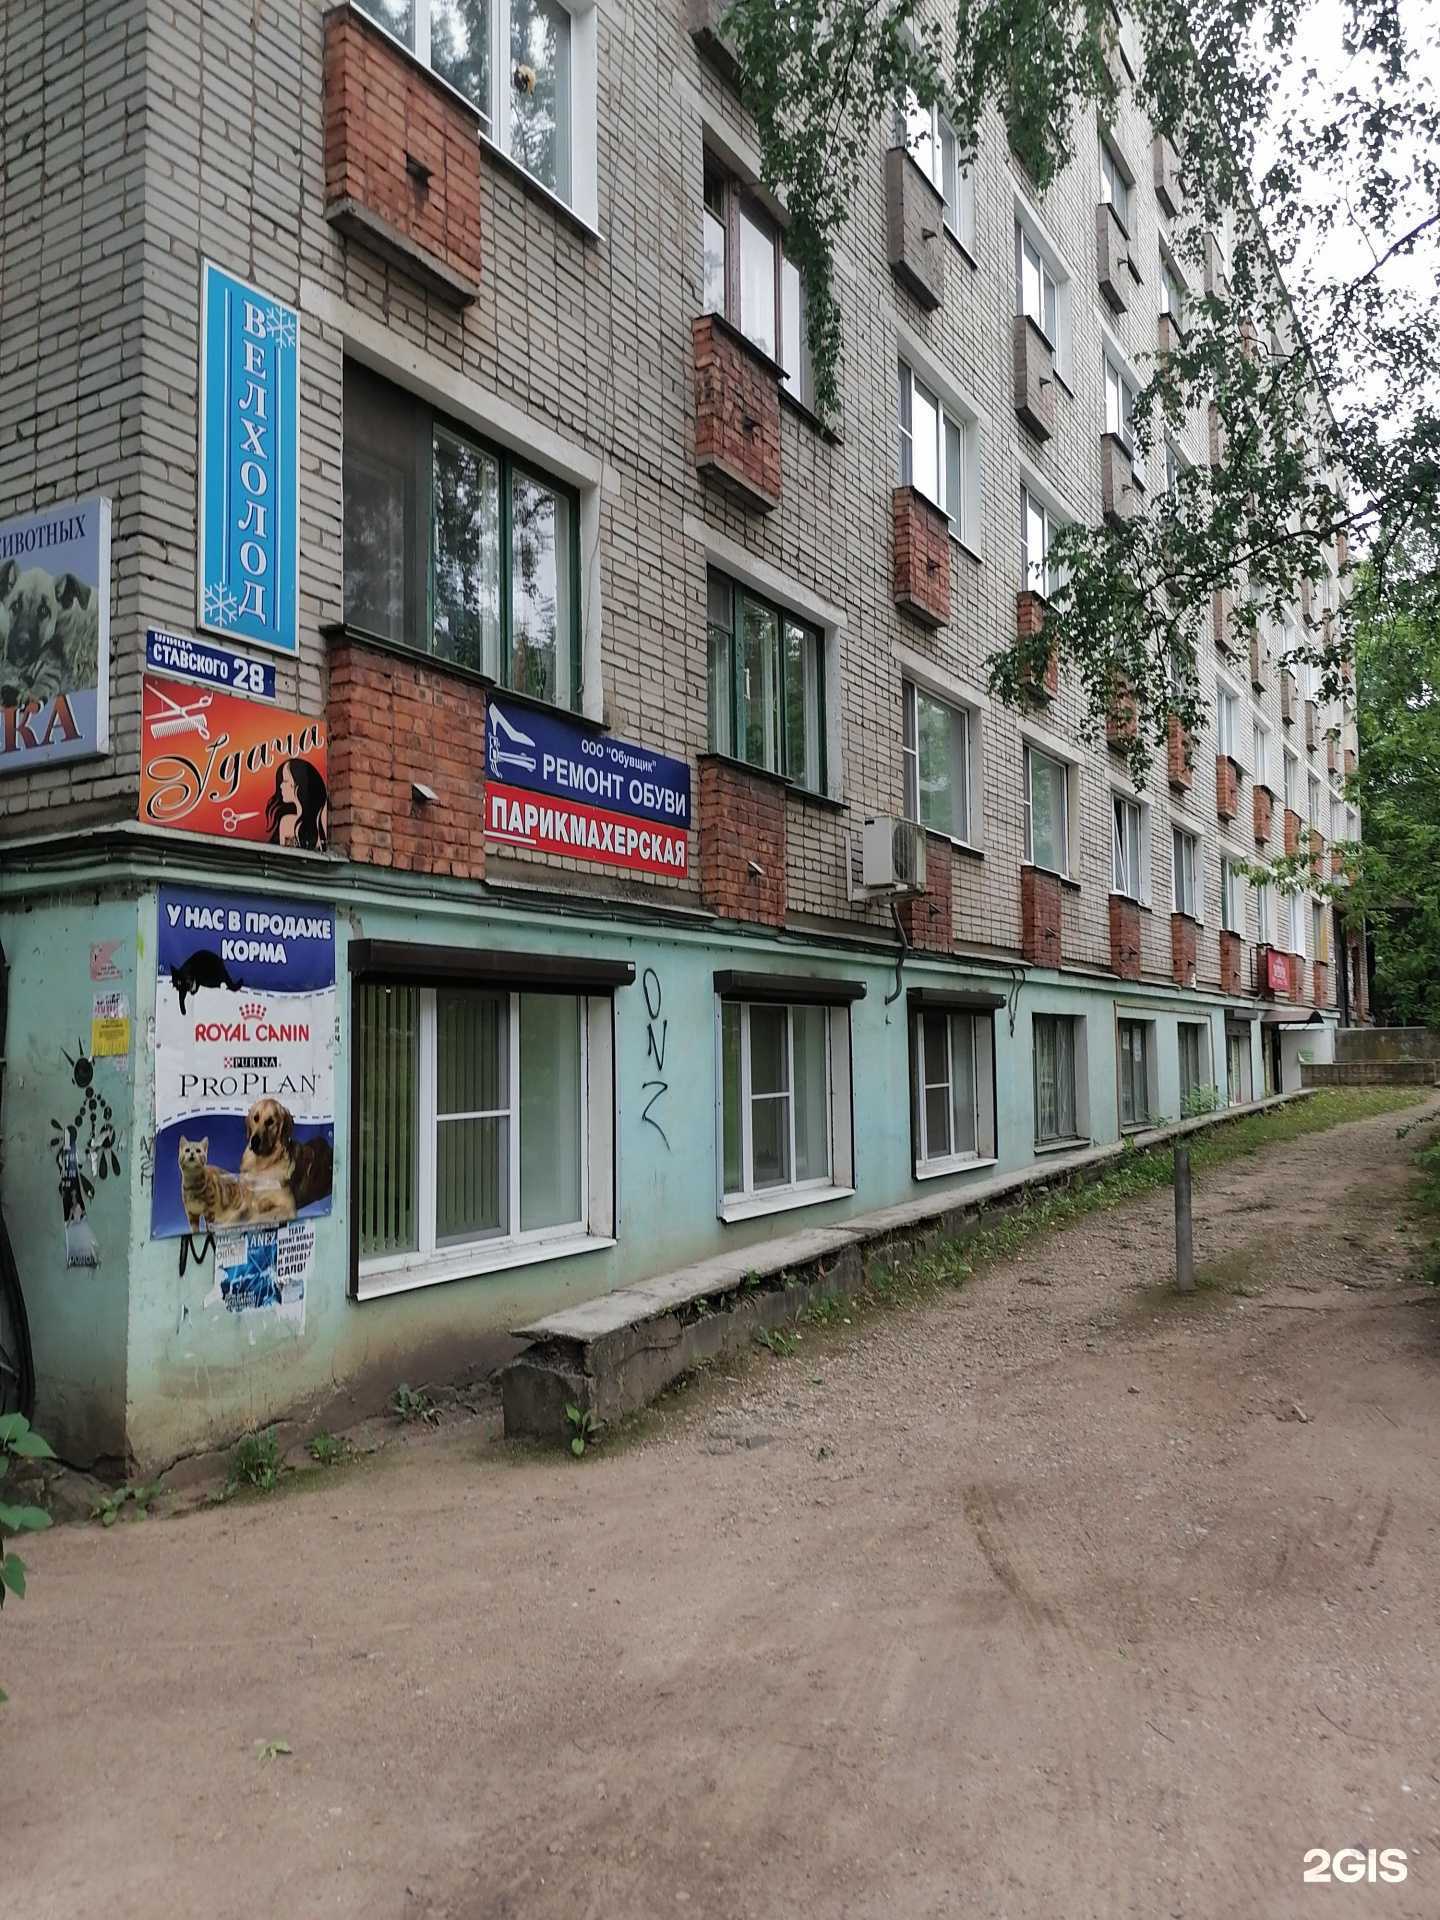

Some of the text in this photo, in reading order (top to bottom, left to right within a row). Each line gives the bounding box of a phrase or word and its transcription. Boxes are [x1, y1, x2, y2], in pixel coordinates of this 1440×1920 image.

[239, 299, 268, 627] ВЕЛХОЛОД
[0, 513, 86, 560] ИВОТНЫХ
[153, 643, 265, 694] СТАВСКОГО 28
[146, 723, 325, 823] Удача
[581, 739, 657, 773] ООО "Обувщик"
[542, 753, 686, 817] РЕМОНТ ОБУВИ
[491, 796, 685, 867] ПАРИКМАХЕРСКАЯ
[166, 903, 332, 940] У НАС В ПРОДАЖЕ
[221, 938, 287, 964] КОРМА
[194, 1024, 310, 1042] ROYAL CANIN
[234, 1056, 277, 1068] PURINA
